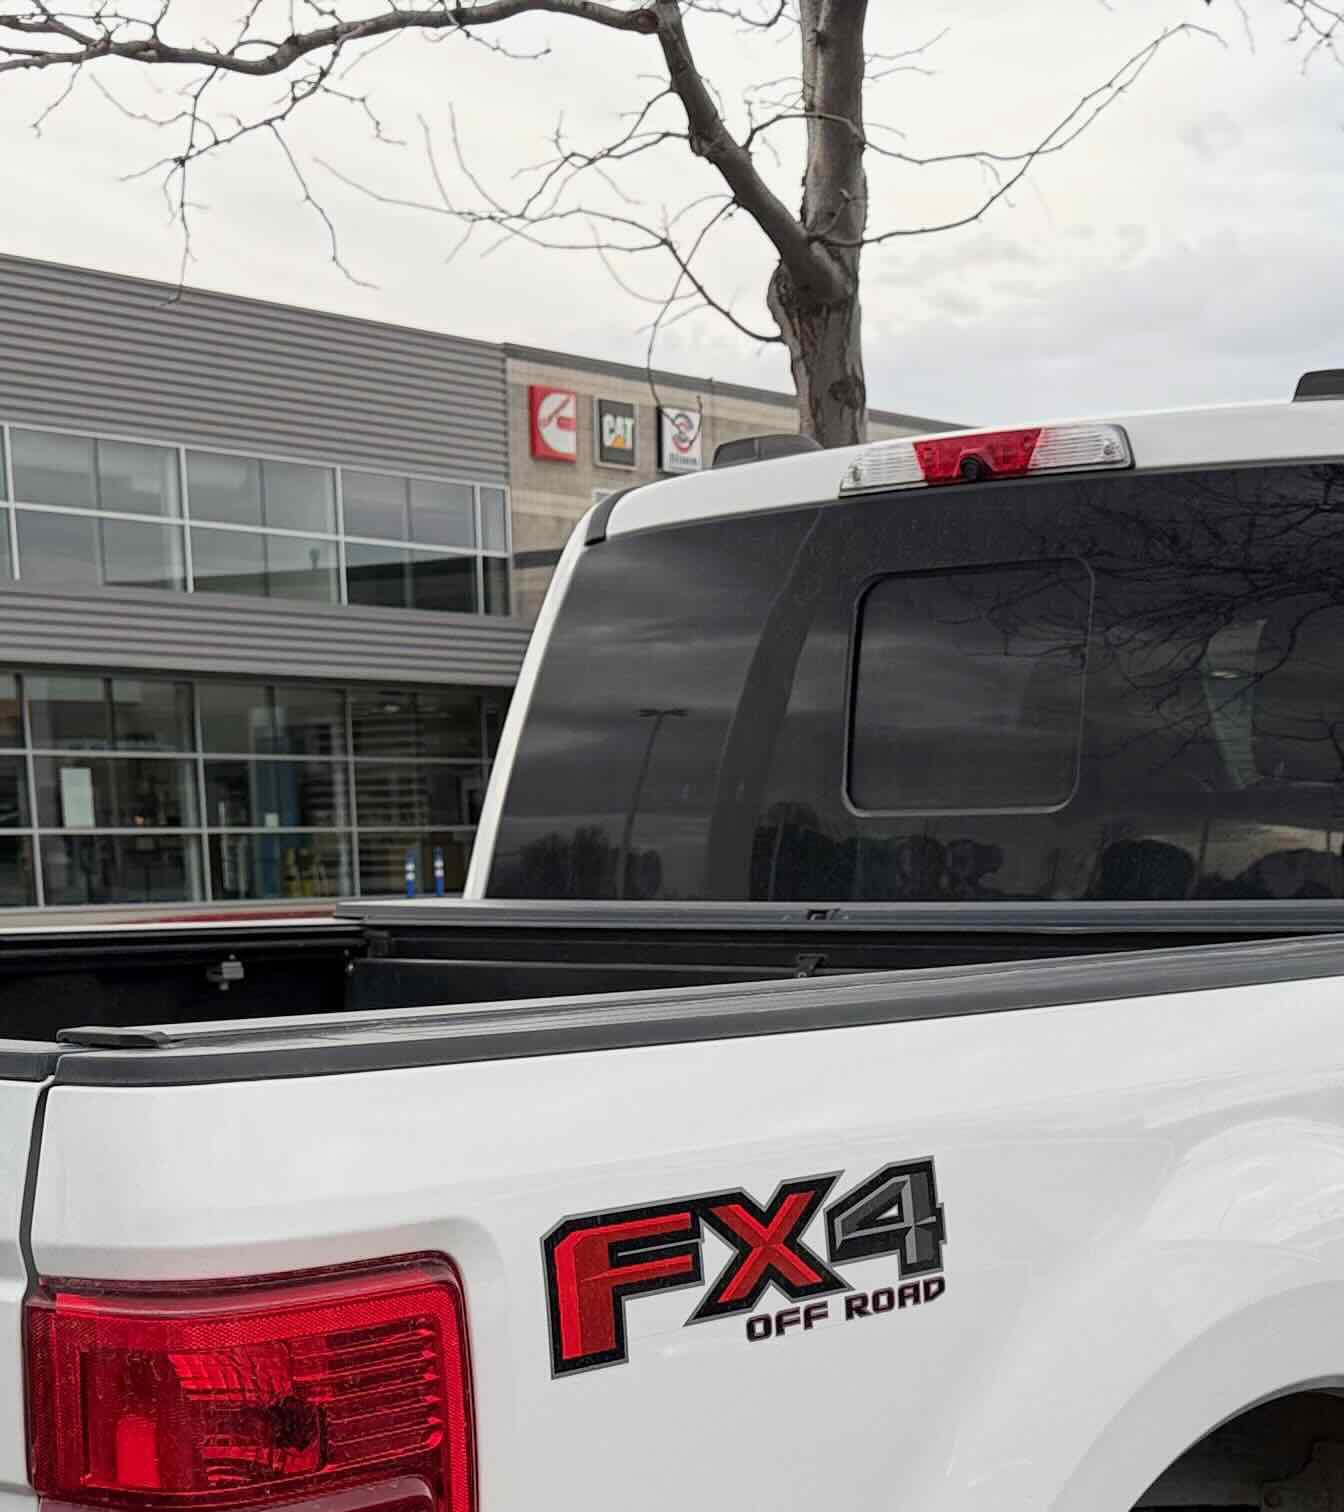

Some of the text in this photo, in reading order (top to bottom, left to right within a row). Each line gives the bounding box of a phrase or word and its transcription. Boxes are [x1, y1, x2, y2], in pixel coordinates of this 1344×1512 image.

[602, 413, 635, 448] CAT
[539, 1155, 947, 1380] FX4
[745, 1275, 947, 1343] OFF ROAD
